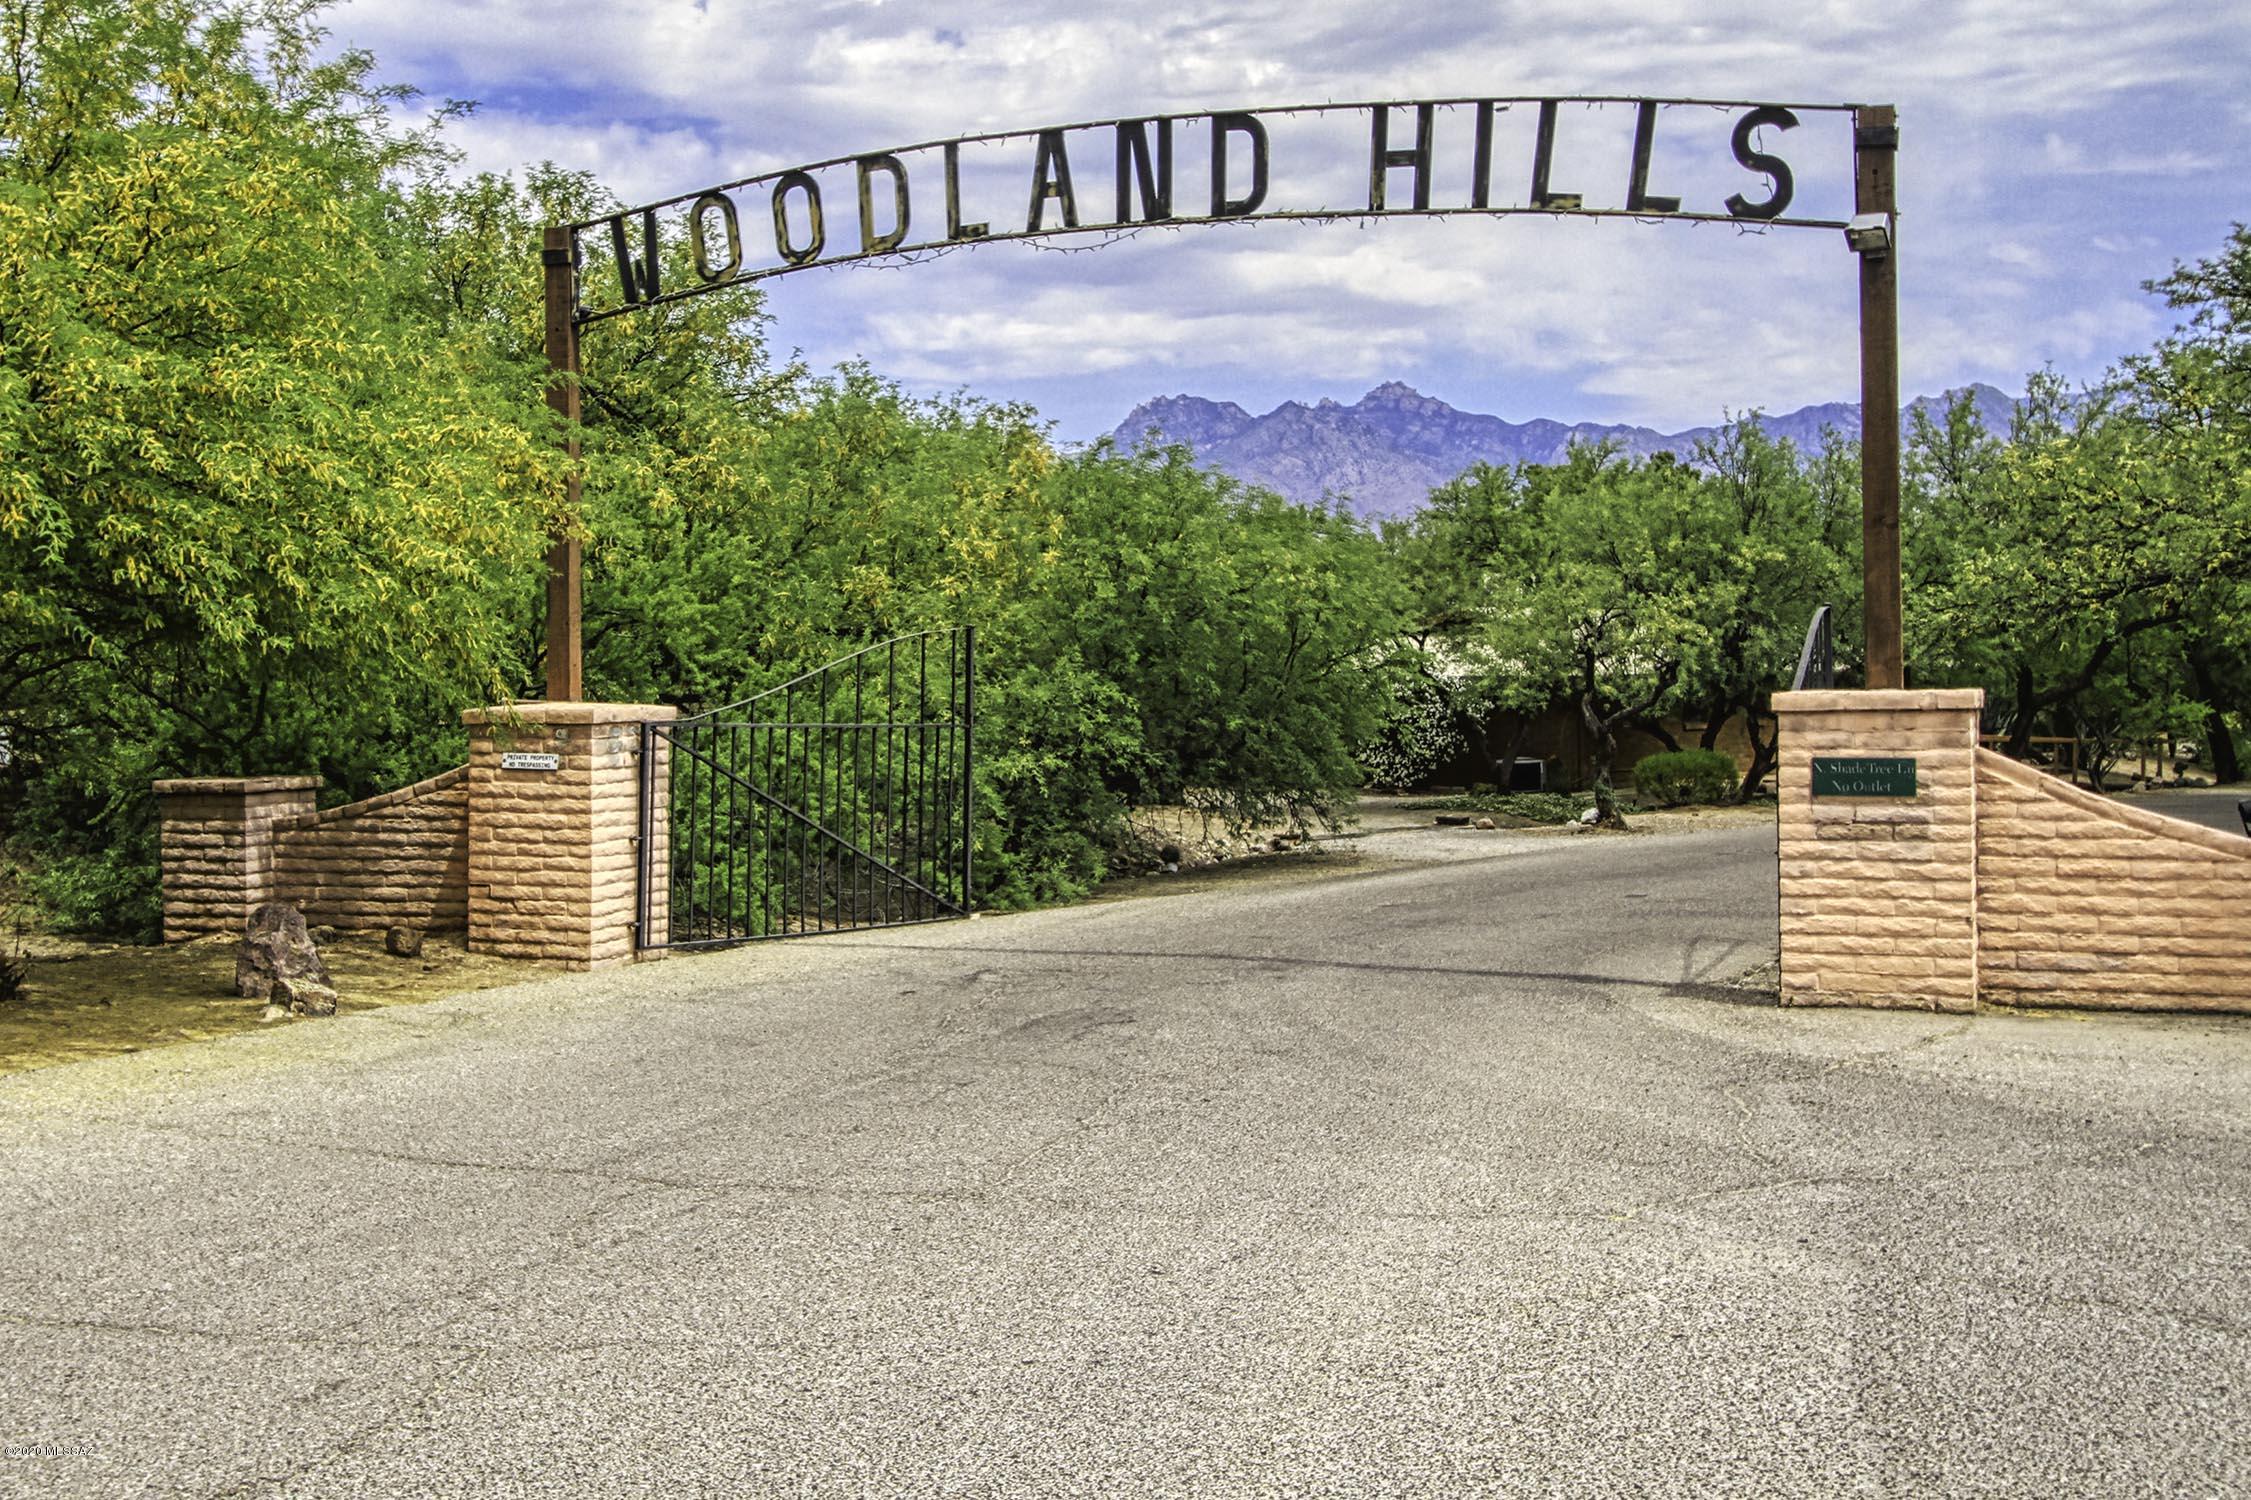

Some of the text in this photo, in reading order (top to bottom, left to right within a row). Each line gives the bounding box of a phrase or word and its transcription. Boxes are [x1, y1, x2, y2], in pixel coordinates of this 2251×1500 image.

[610, 101, 1799, 305] WOODLAND HILLS
[1830, 761, 1867, 774] Shade
[1870, 761, 1894, 774] Tree
[1832, 780, 1892, 792] No Outlet
